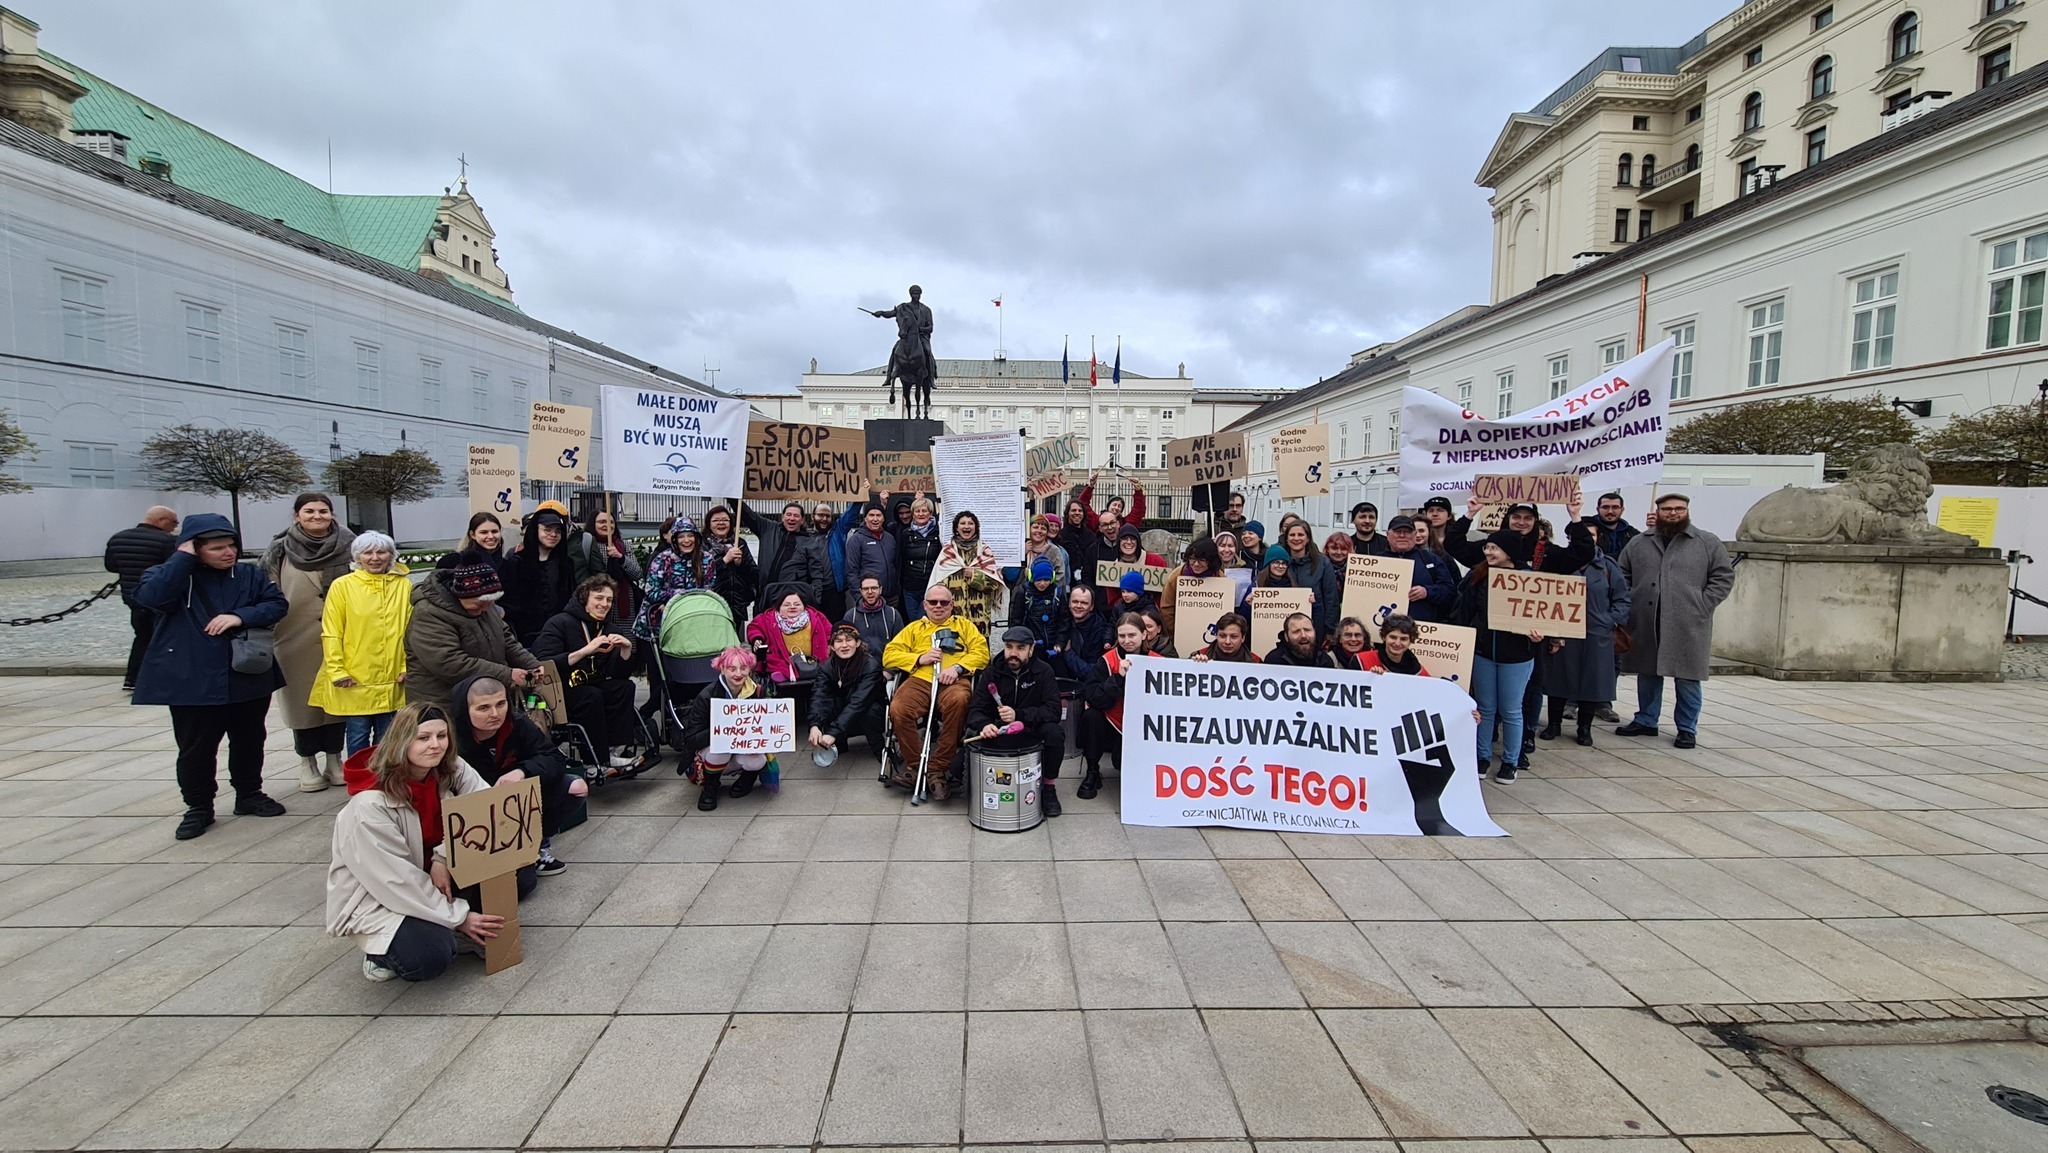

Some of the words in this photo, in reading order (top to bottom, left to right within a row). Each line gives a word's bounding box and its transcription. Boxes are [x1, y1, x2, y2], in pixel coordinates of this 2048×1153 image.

[1564, 376, 1630, 415] ŻYCIA
[533, 403, 566, 414] Godne
[637, 393, 675, 410] MAŁE
[679, 397, 718, 414] DOMY
[532, 413, 558, 423] życie
[1439, 428, 1472, 444] DLA
[1477, 412, 1596, 443] OPIEKUNEK
[1603, 389, 1651, 424] OSÓB
[653, 413, 701, 434] MUSZĄ
[532, 424, 546, 432] dla
[547, 425, 586, 437] każdego
[762, 423, 830, 449] STOP
[1280, 428, 1307, 436] Godne
[623, 428, 650, 445] BYĆ
[653, 432, 666, 446] W
[670, 434, 728, 451] USTAWIE
[1280, 438, 1301, 446] życie
[1432, 451, 1441, 464] Z
[1447, 416, 1663, 464] NIEPEŁNOSPRAWNOŚCIAMI!
[469, 446, 495, 455] Godne
[470, 457, 490, 466] życie
[744, 446, 858, 474] STEMOWEMU
[1174, 453, 1201, 467] DLA
[470, 468, 480, 476] dla
[482, 467, 516, 477] każdego
[652, 477, 700, 486] Porozumienie
[746, 468, 861, 495] EWOLNICTWU
[875, 477, 893, 485] MA
[1476, 476, 1504, 503] CZAS
[1507, 476, 1524, 500] NA
[1527, 476, 1577, 503] ZMIANY
[1350, 557, 1378, 567] STOP
[1348, 568, 1400, 581] przemocy
[1179, 578, 1204, 587] STOP
[1347, 578, 1398, 592] finansowej
[1492, 573, 1586, 596] ASYSTENT
[1178, 590, 1224, 599] przemocy
[1254, 590, 1279, 598] STOP
[1178, 600, 1223, 610] finansowej
[1254, 601, 1300, 611] przemocy
[1507, 597, 1582, 623] TERAZ
[1410, 647, 1459, 663] nansowej
[1144, 669, 1373, 709] NIEPEDAGOGICZNE
[735, 715, 761, 726] OZN
[770, 725, 786, 734] NIE
[1143, 711, 1378, 756] NIEZAUWAŻALNE
[730, 737, 770, 749] ŚMIEJE
[1155, 756, 1255, 799] DOŚĆ
[1264, 764, 1368, 813] TEGO!
[448, 784, 542, 868] POLSKA
[1273, 811, 1360, 829] PRACOWNICZA
